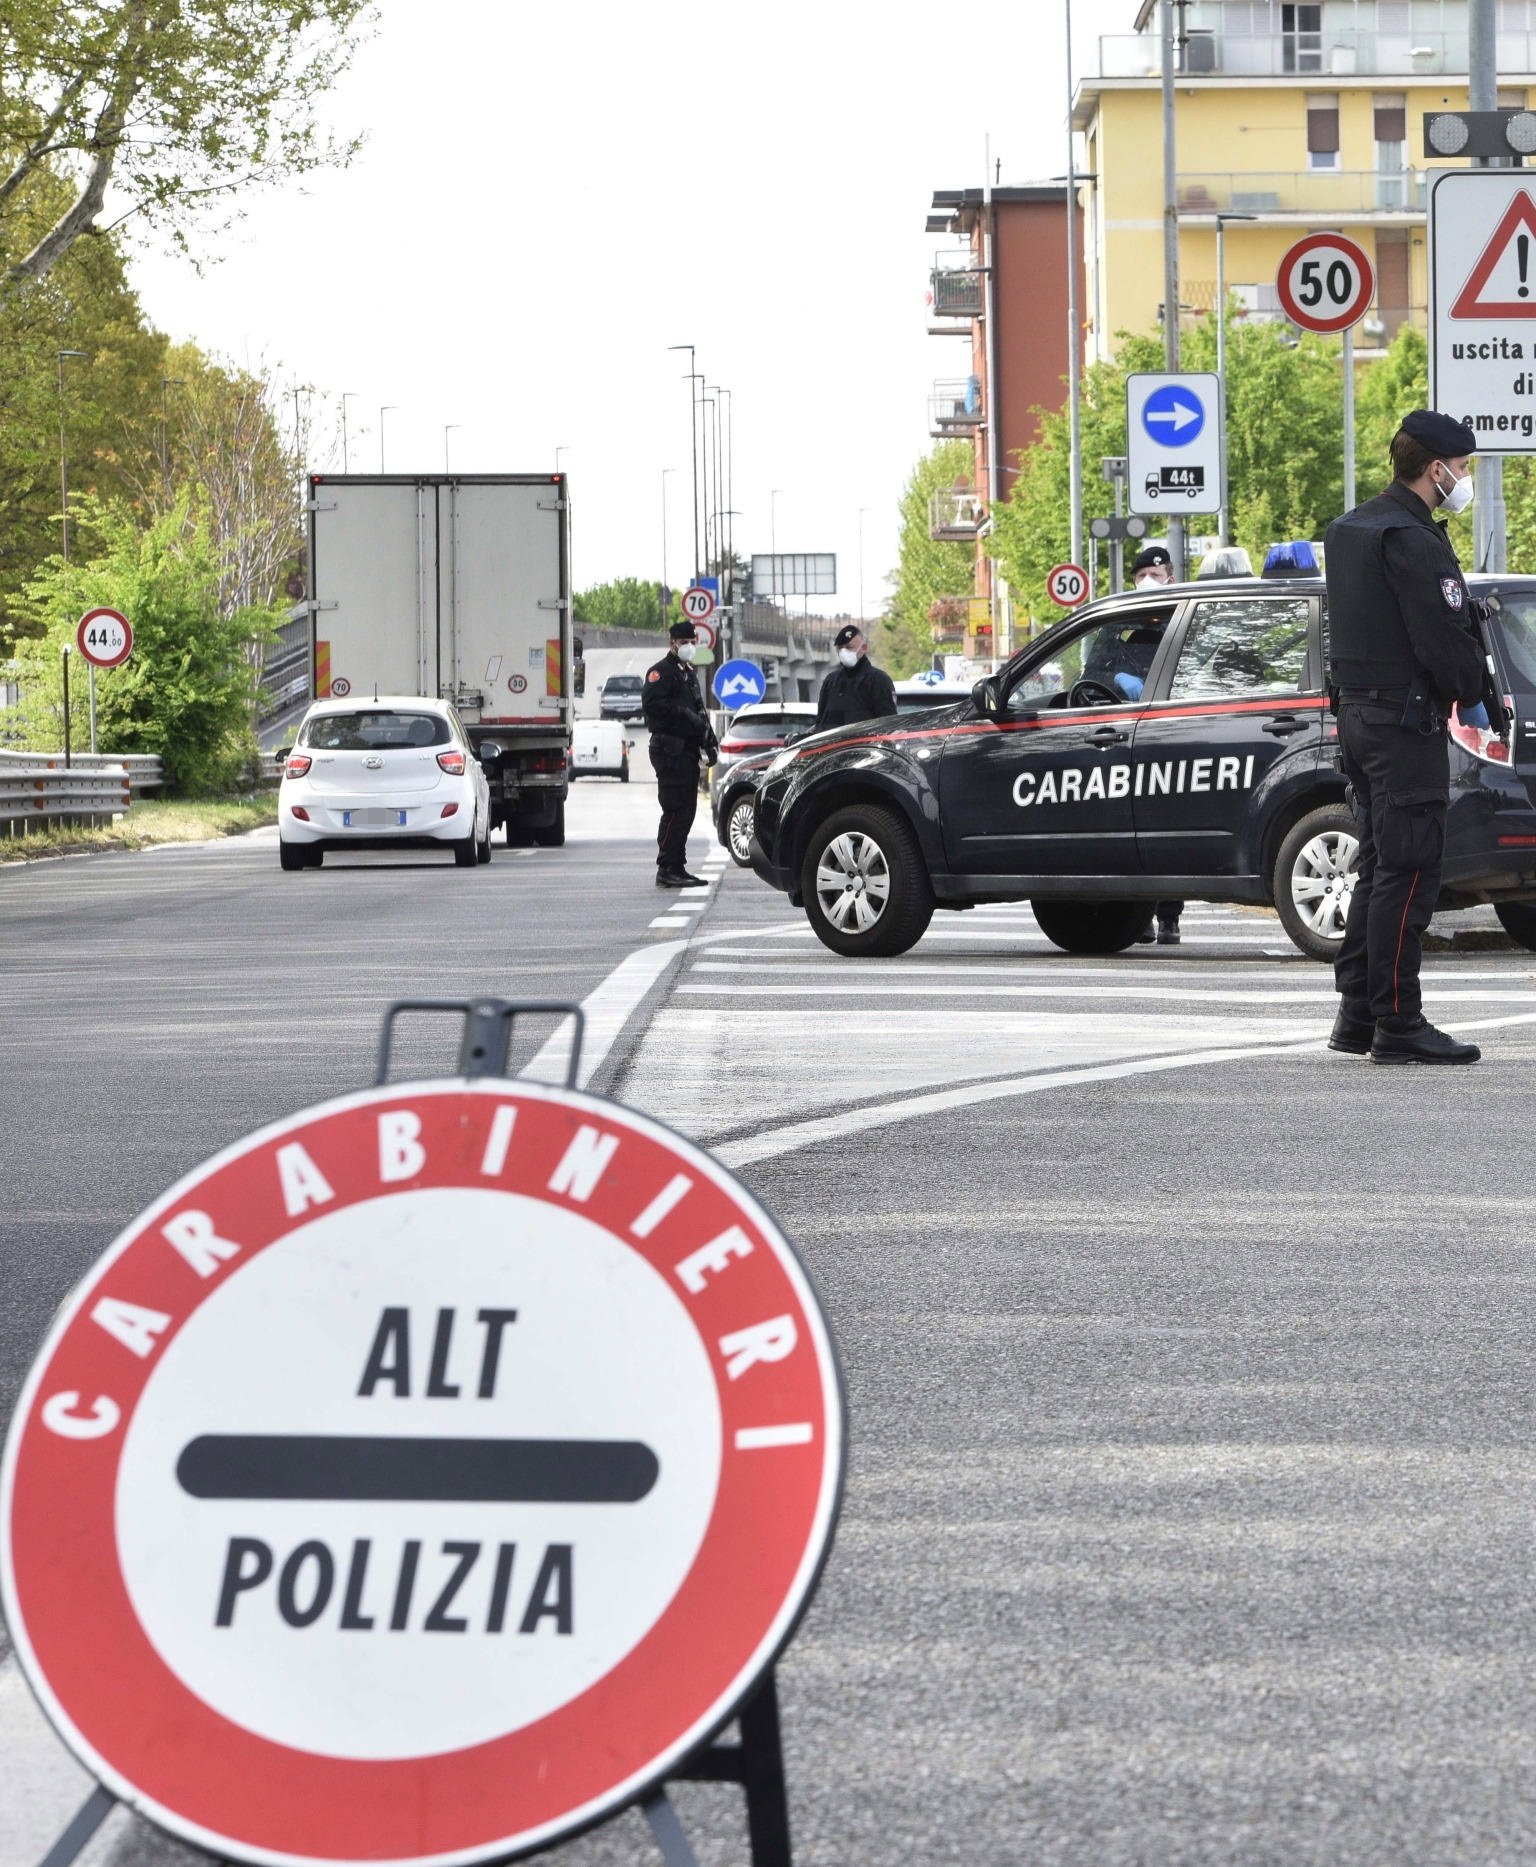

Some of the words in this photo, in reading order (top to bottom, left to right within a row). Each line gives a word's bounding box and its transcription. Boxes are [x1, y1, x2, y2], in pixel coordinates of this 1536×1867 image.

[1299, 260, 1352, 306] 50
[1452, 336, 1524, 360] uscita
[1513, 372, 1534, 395] di
[1169, 469, 1196, 485] 44t
[1057, 575, 1081, 596] 50
[689, 595, 707, 612] 70
[88, 629, 107, 646] 44
[1012, 755, 1255, 807] CARABINIERI
[41, 1104, 815, 1452] CARABINIERI
[357, 1306, 518, 1400] ALT
[213, 1537, 577, 1636] POLIZIA
